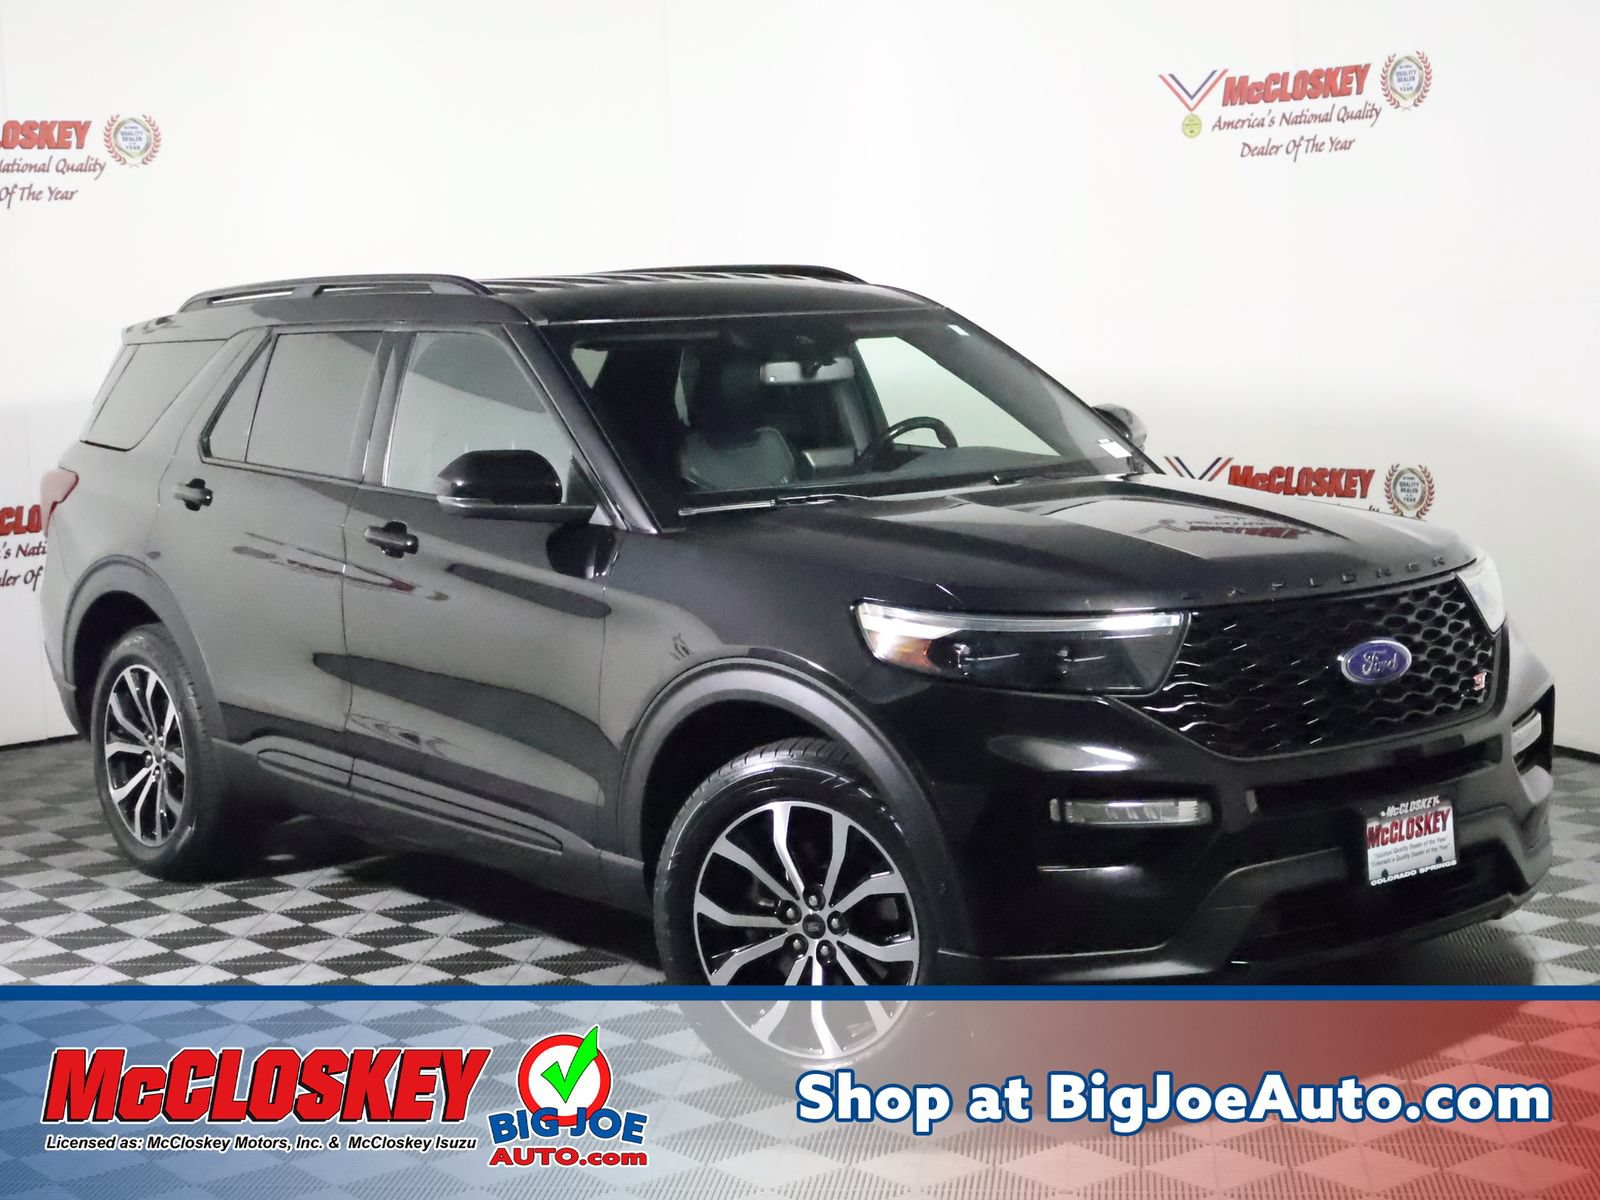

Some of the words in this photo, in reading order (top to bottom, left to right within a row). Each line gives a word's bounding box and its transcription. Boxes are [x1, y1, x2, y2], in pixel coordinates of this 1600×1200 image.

[1222, 63, 1371, 107] McCLOSKEY
[1211, 108, 1276, 132] America's
[1279, 101, 1333, 127] National
[1337, 103, 1382, 128] Quality
[0, 120, 92, 150] OSKEY
[1240, 138, 1283, 158] Dealer
[1285, 135, 1305, 162] Of
[1304, 134, 1325, 154] The
[1328, 135, 1356, 153] Year
[55, 155, 106, 181] Quality
[0, 183, 18, 209] Of
[18, 183, 43, 201] The
[47, 186, 78, 202] Year
[1228, 465, 1375, 499] McCLOSKEY
[23, 565, 44, 592] Of
[1360, 650, 1400, 675] Ford
[1386, 795, 1440, 818] McCLOSKEY
[1367, 808, 1451, 849] McCLOSKEY
[1370, 869, 1417, 886] COLORADO
[1418, 860, 1457, 874] SPRINGS
